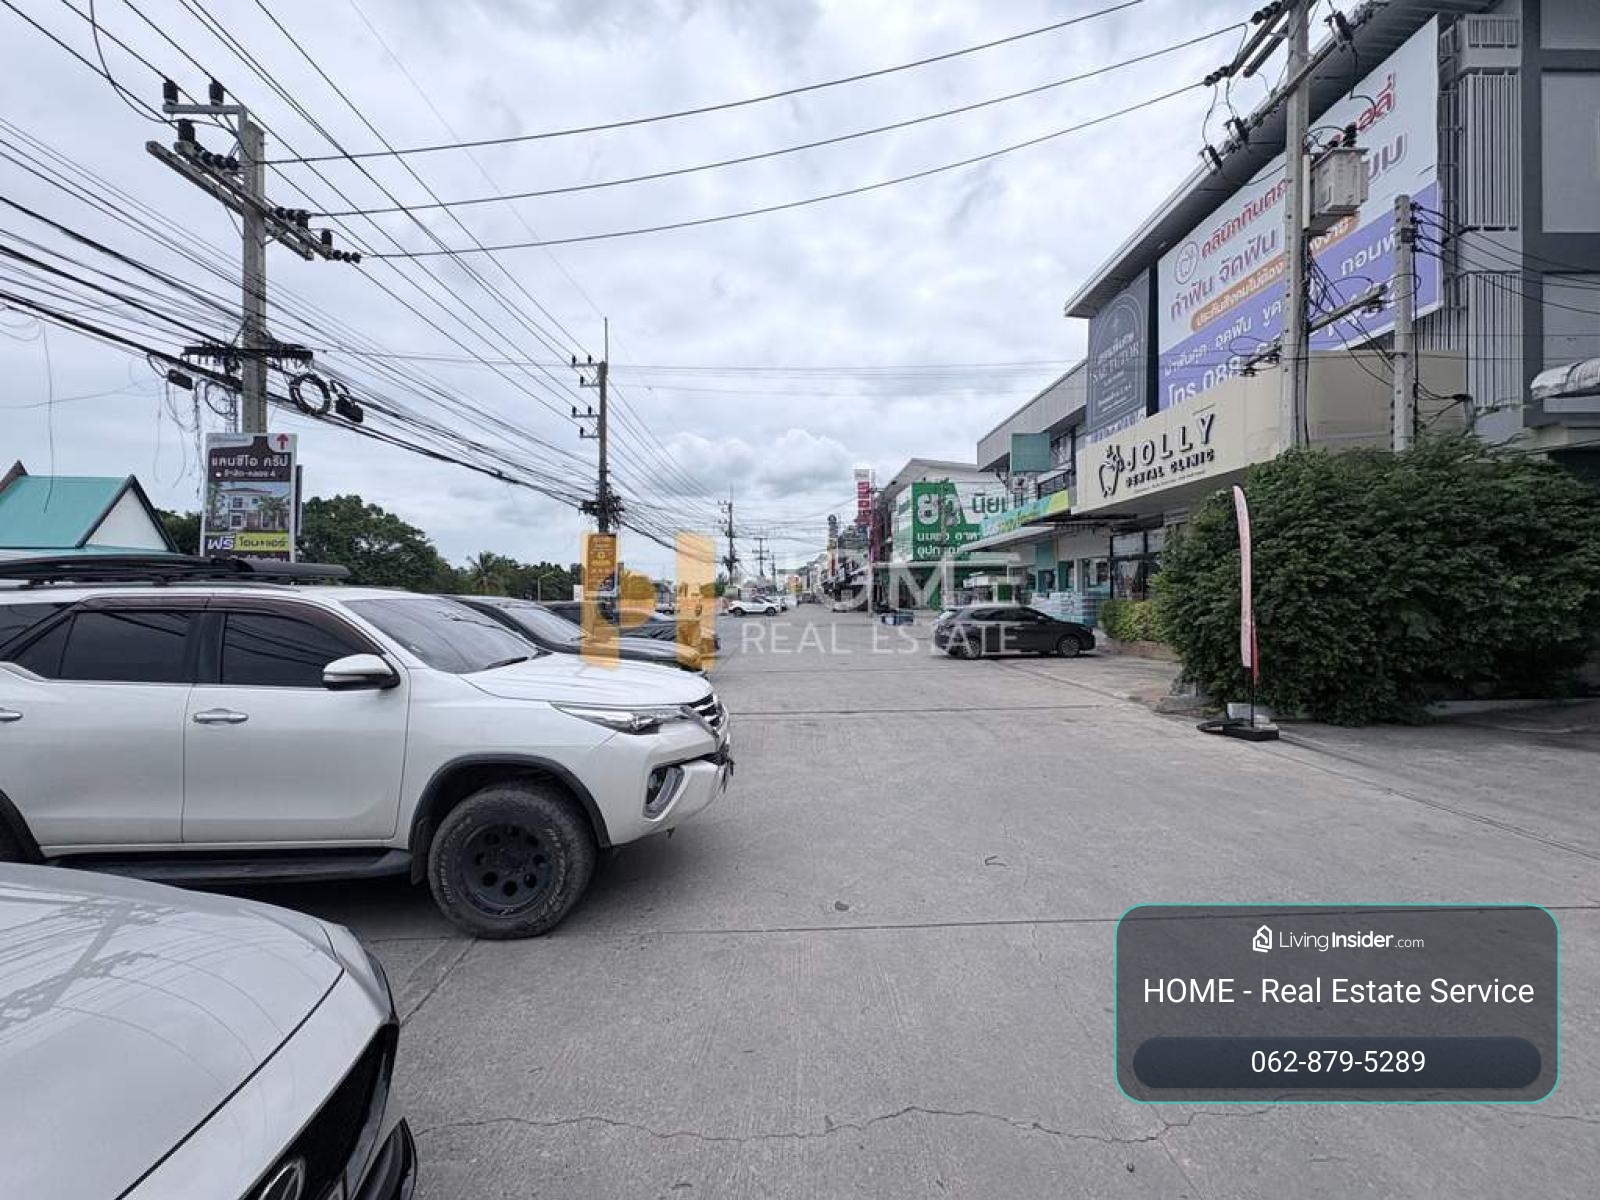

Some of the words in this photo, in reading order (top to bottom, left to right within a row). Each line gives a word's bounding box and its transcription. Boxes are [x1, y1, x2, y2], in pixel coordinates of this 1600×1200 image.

[1127, 413, 1216, 472] JOLLY
[1125, 465, 1166, 488] DENTAL
[1169, 448, 1216, 473] CLINIC
